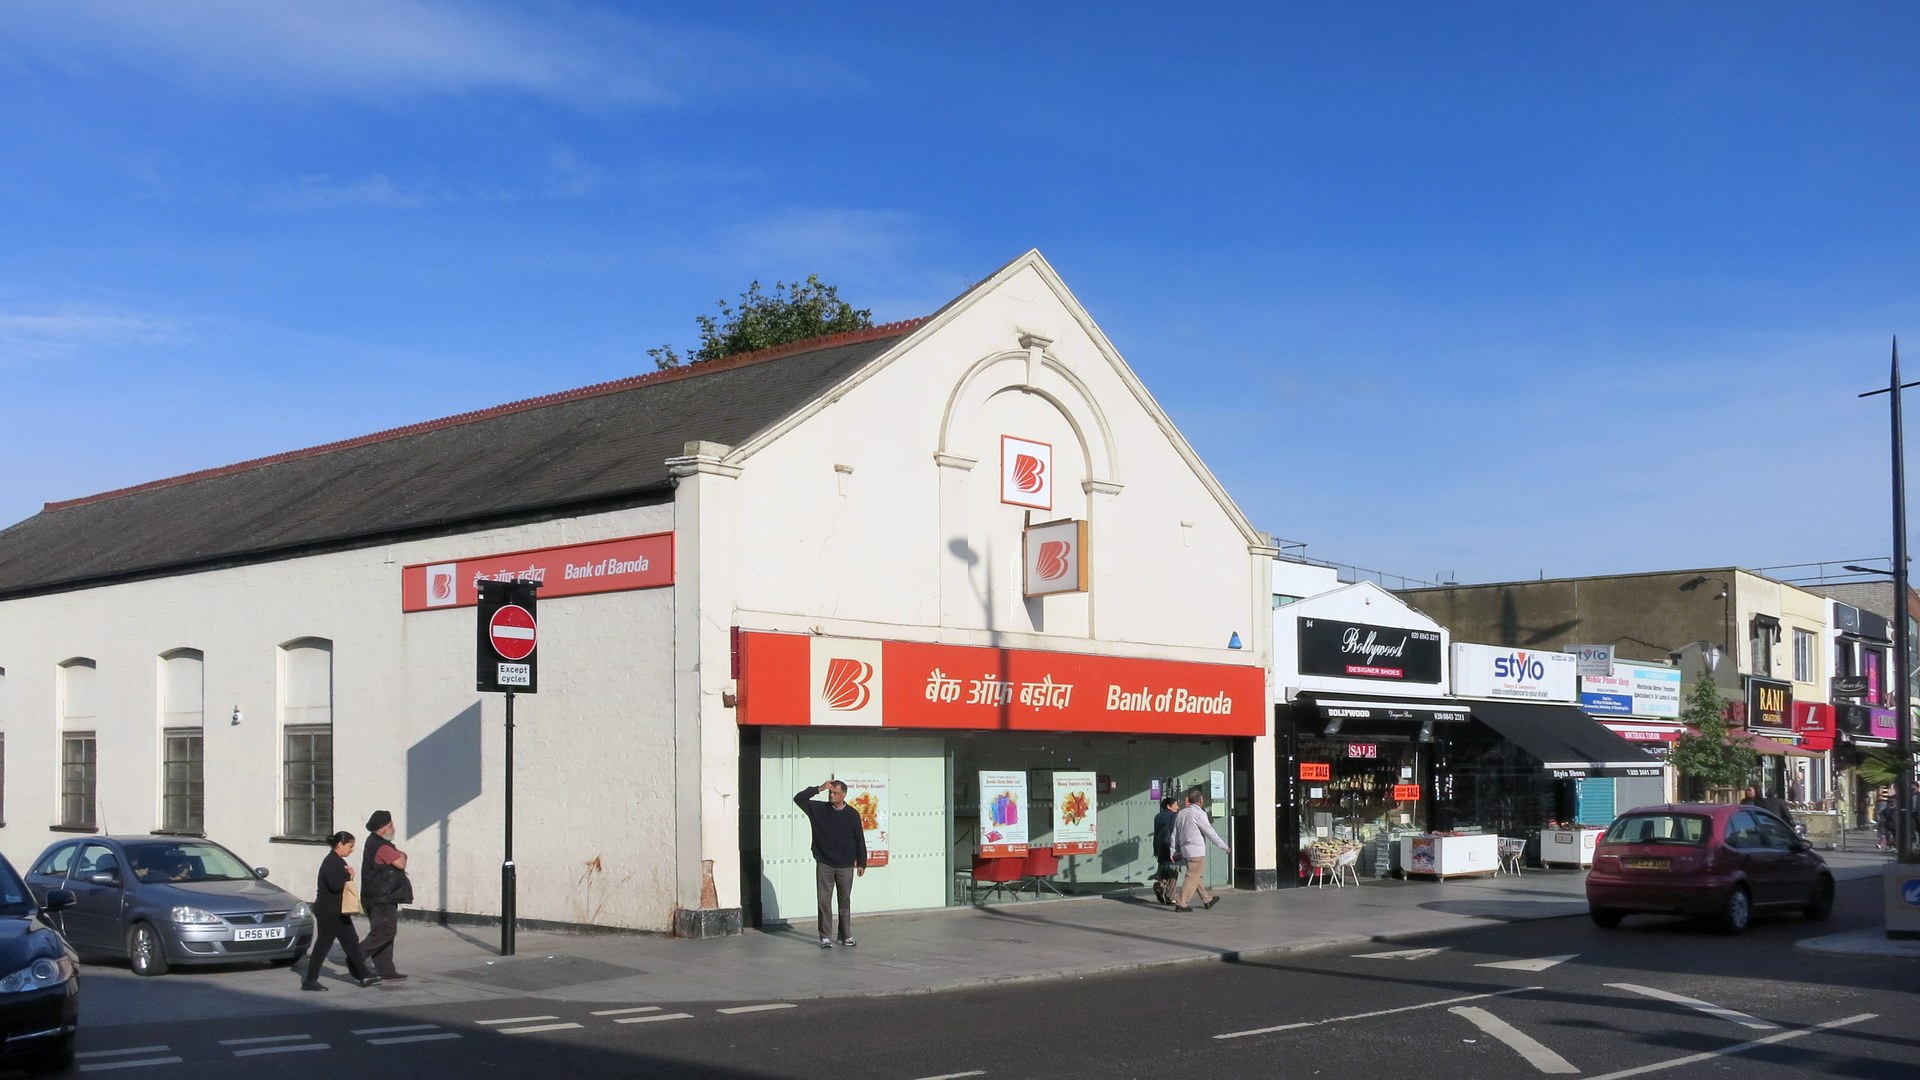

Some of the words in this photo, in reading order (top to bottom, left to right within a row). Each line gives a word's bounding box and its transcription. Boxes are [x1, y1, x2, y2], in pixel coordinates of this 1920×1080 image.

[564, 561, 594, 580] Bank
[594, 559, 608, 577] of
[608, 555, 650, 576] Baroda
[1411, 631, 1419, 639] 020
[1341, 627, 1407, 666] Bollywood
[1577, 649, 1608, 662] tylo
[500, 664, 528, 675] Except
[1348, 665, 1380, 675] DESIGNER
[1380, 667, 1400, 677] SHOES
[1494, 652, 1545, 683] stylo
[501, 675, 527, 684] cycles
[925, 667, 963, 703] बैंक
[966, 673, 1015, 707] ऑफ़
[1019, 673, 1074, 712] बड़ौदा
[1106, 684, 1153, 712] Bank
[1154, 687, 1174, 713] of
[1174, 688, 1232, 715] Baroda
[1760, 687, 1784, 712] RANI
[1328, 708, 1370, 718] BOLLYWOOD
[1350, 744, 1376, 758] SALE
[1315, 766, 1328, 777] SALE
[1553, 769, 1568, 778] Stylo
[1569, 769, 1586, 777] Shoes
[1407, 787, 1418, 798] SALE
[238, 930, 263, 940] LR56
[264, 928, 282, 938] VEV
